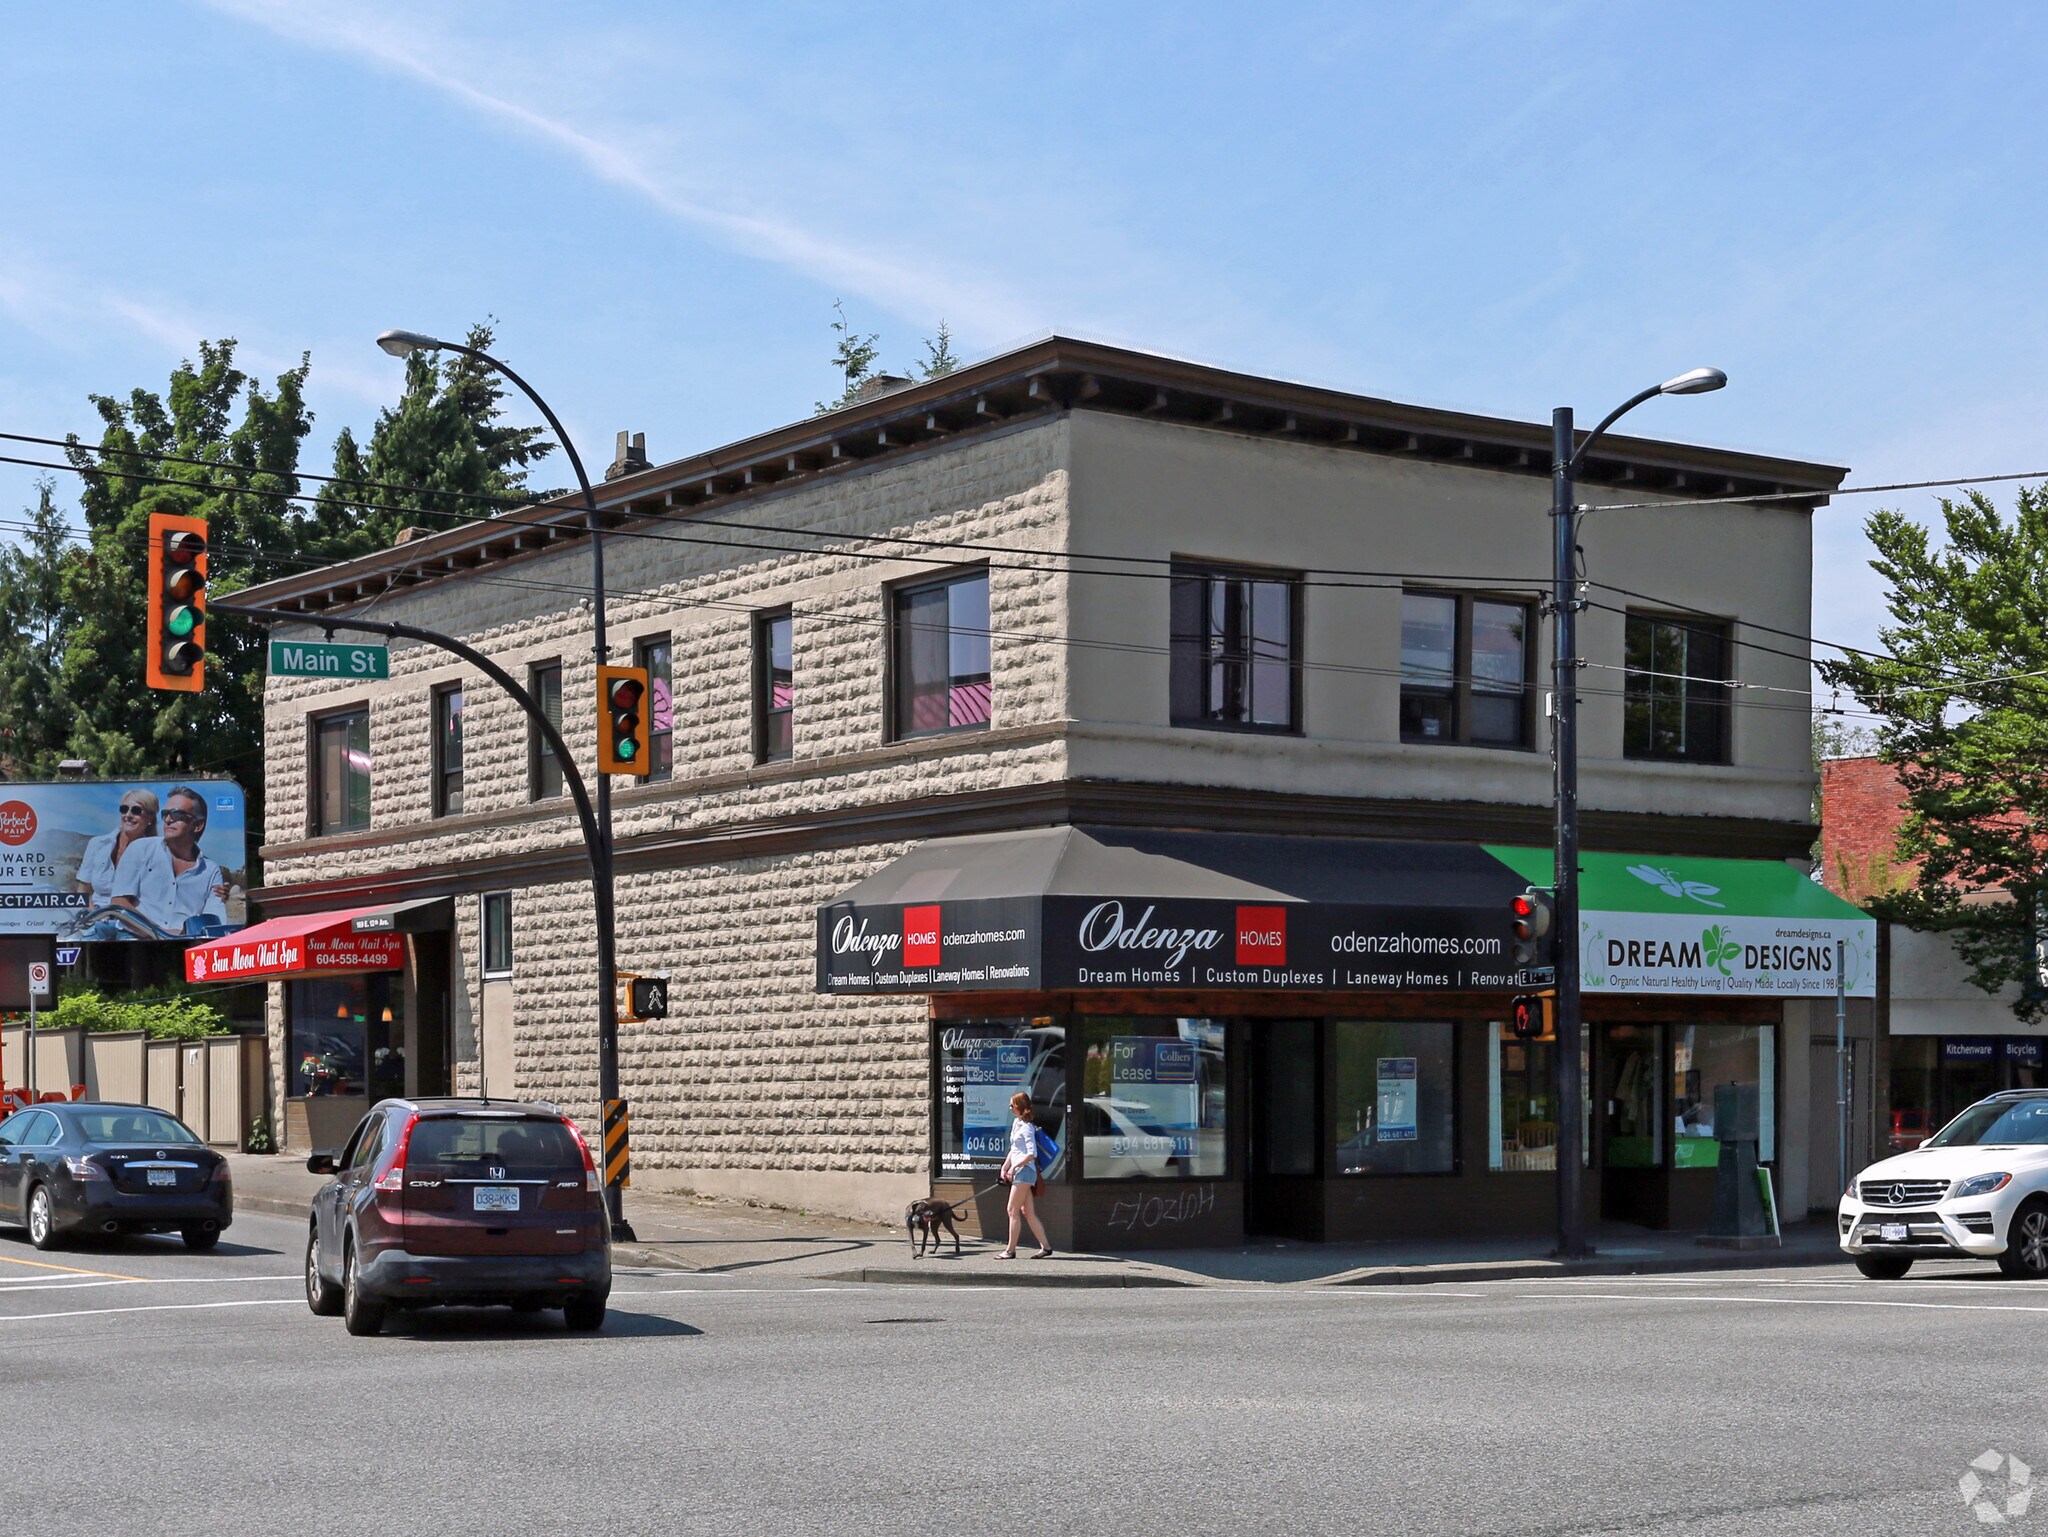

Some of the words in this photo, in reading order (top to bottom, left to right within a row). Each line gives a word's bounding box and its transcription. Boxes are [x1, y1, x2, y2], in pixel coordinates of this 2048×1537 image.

[283, 648, 339, 672] Main
[350, 650, 376, 673] St
[0, 811, 33, 830] Perfect
[21, 866, 55, 877] EYES
[832, 915, 902, 966] Odenza
[907, 931, 937, 946] HOMES
[943, 928, 1026, 946] odenzahomes.com
[1079, 900, 1224, 969] Odenza
[1240, 930, 1282, 946] HOMES
[1331, 930, 1501, 954] odenzahomes.com
[1775, 928, 1831, 941] dreamdesigns.ca
[307, 937, 326, 950] Sun
[330, 937, 355, 950] Moon
[357, 937, 380, 950] Nail
[382, 937, 401, 951] Spa
[212, 949, 229, 973] Sun
[230, 943, 255, 971] Moon
[256, 940, 278, 968] Nail
[279, 940, 298, 965] Spa
[316, 954, 388, 965] 604-558-4499
[1608, 939, 1702, 968] DREAM
[1745, 944, 1832, 972] DESIGNS
[827, 973, 847, 986] Dream
[848, 972, 870, 986] Homes
[874, 971, 899, 984] Custom
[900, 970, 928, 987] Duplexes
[932, 969, 960, 984] Laneway
[961, 967, 985, 981] Homes
[990, 963, 1030, 979] Renovations
[1079, 967, 1127, 983] Dream
[1131, 967, 1180, 982] Homes
[1206, 968, 1258, 983] Custom
[1263, 969, 1324, 987] Duplexes
[1347, 970, 1402, 988] Laneway
[1406, 971, 1449, 985] Homes
[1610, 974, 1639, 990] Organic
[1642, 975, 1669, 987] Natural
[1671, 976, 1699, 990] Healthy
[1700, 976, 1721, 991] Living
[1727, 976, 1752, 991] Quality
[1754, 978, 1774, 989] Made
[1777, 978, 1800, 992] Locally
[1802, 978, 1820, 989] Since
[942, 1028, 981, 1056] Odenza
[983, 1041, 1003, 1049] HOMES
[1113, 1042, 1136, 1059] For
[1946, 1044, 1992, 1055] Kitchenware
[2006, 1044, 2037, 1056] Bicycles
[1000, 1052, 1026, 1064] Colliers
[1159, 1050, 1191, 1062] Colliers
[1113, 1064, 1152, 1080] Lease
[966, 1136, 986, 1151] 604
[988, 1137, 1005, 1152] 681
[1114, 1136, 1139, 1151] 604
[1143, 1136, 1167, 1151] 681
[1169, 1136, 1193, 1151] 4111
